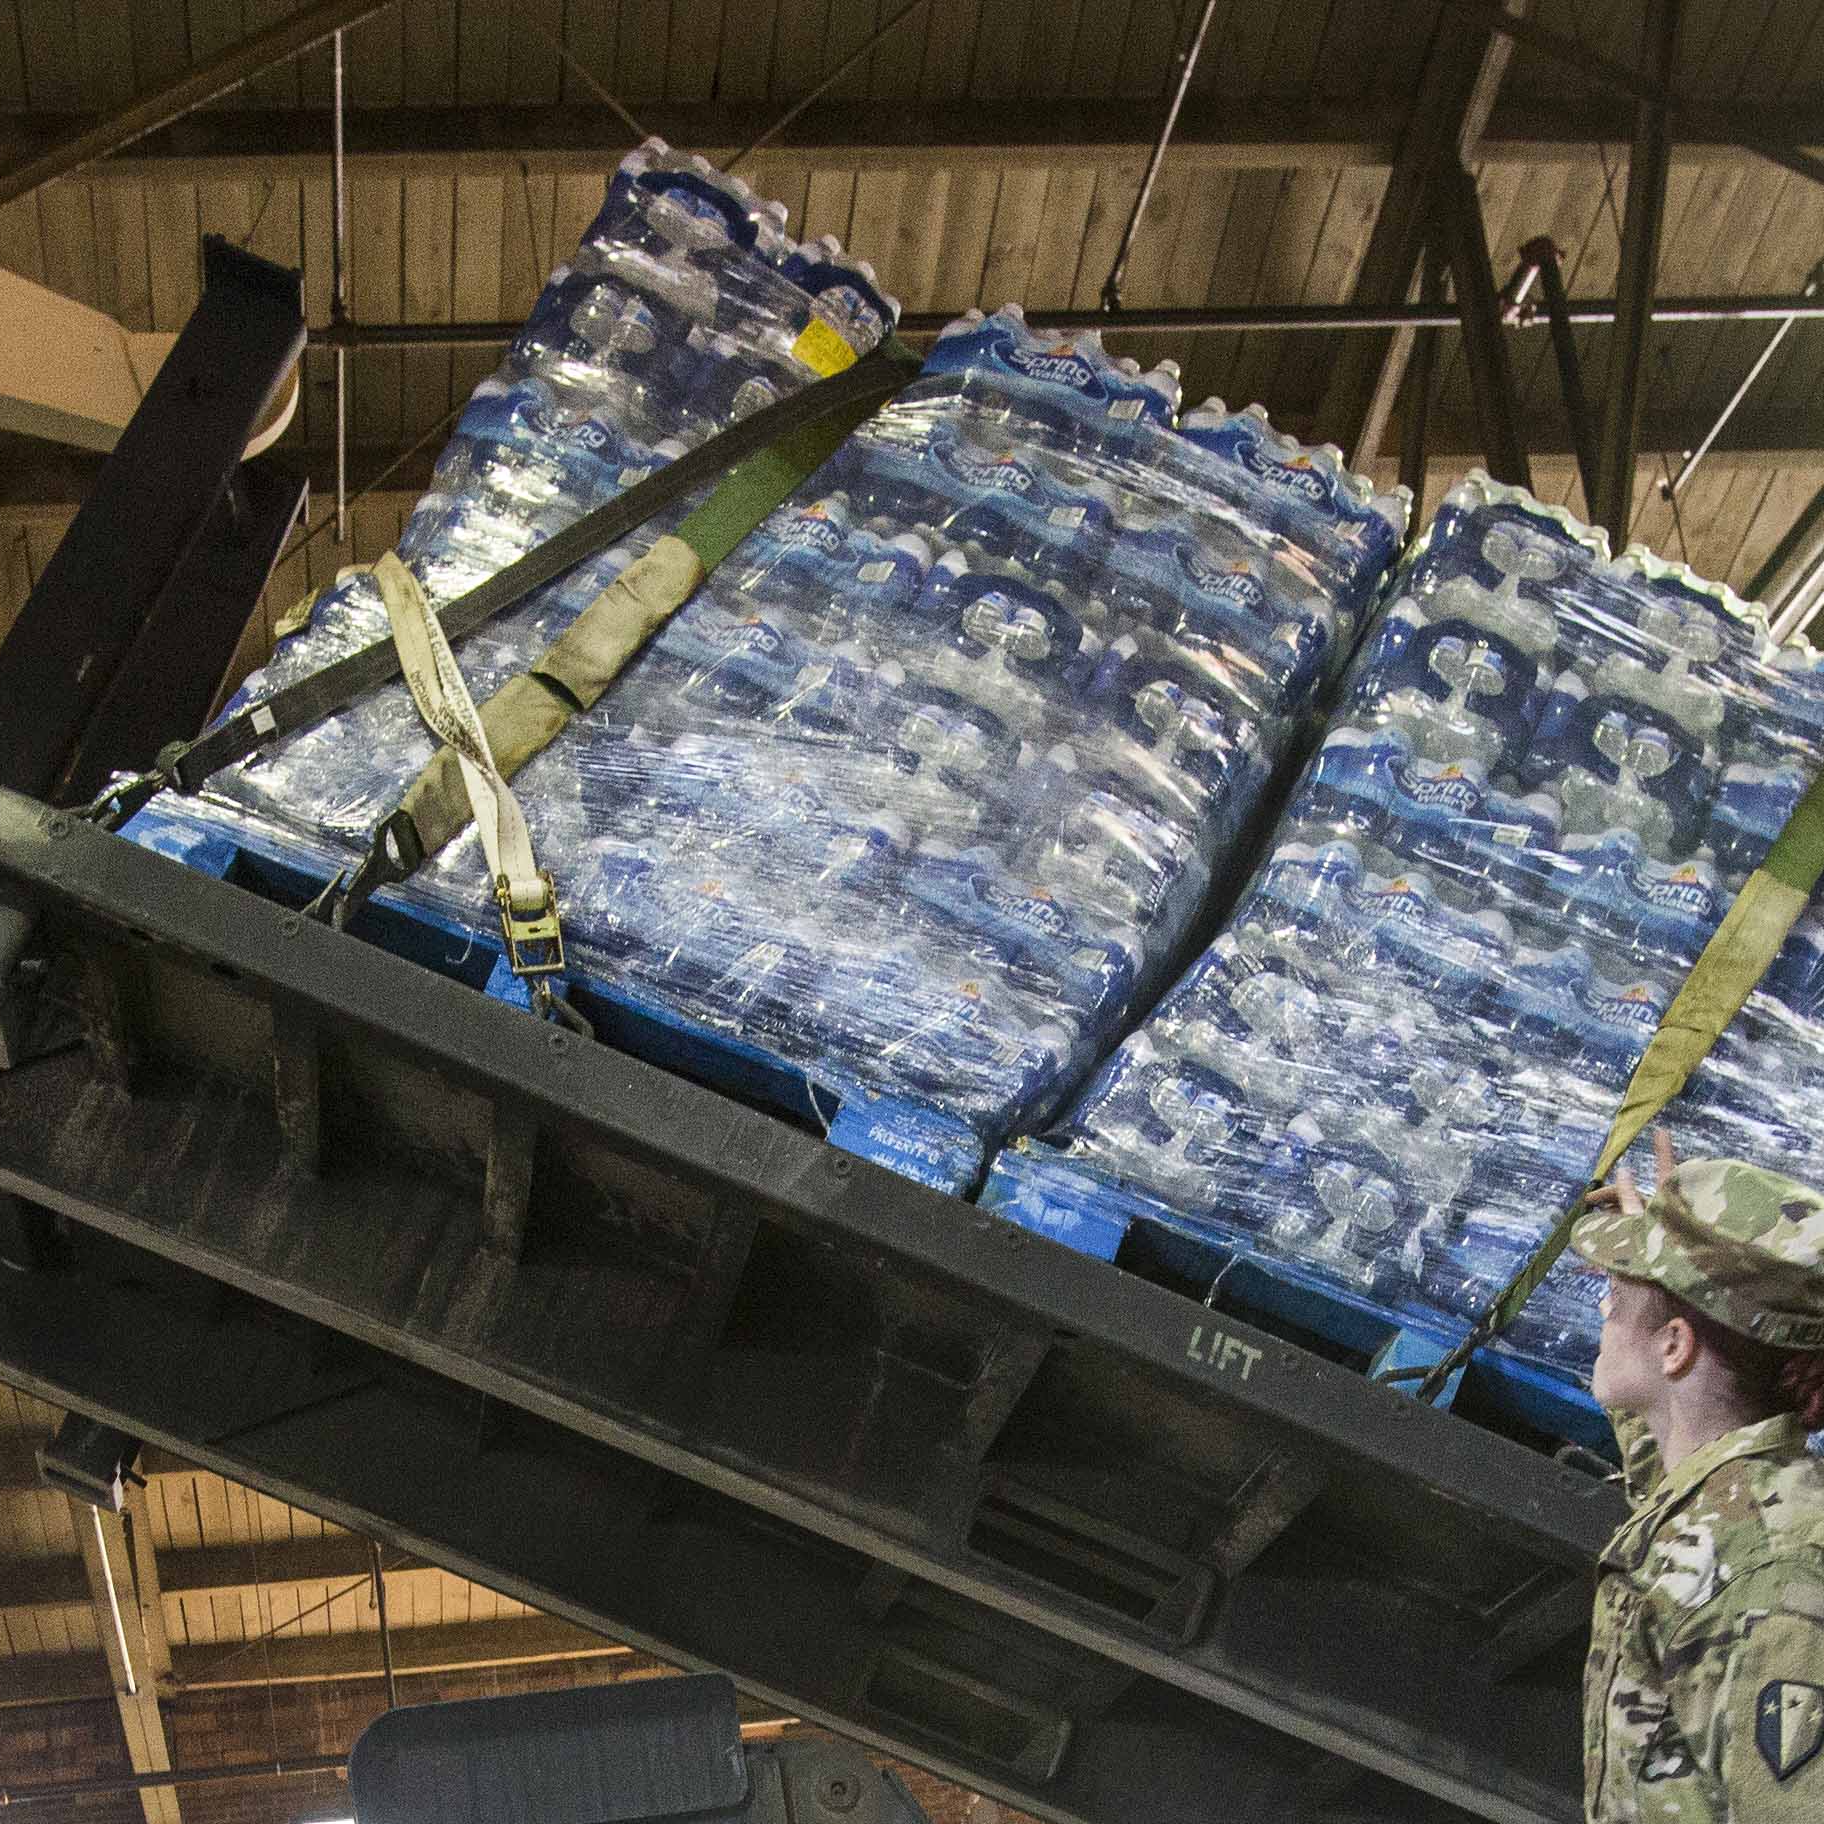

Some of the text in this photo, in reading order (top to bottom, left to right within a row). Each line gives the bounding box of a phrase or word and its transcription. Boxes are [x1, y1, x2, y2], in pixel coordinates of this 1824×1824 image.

[1009, 348, 1091, 387] Spring
[1248, 451, 1325, 500] Spring
[1186, 555, 1265, 606] Spring
[1400, 768, 1478, 809] Spring
[1632, 872, 1713, 916] Spring
[1187, 1326, 1263, 1381] LIFT
